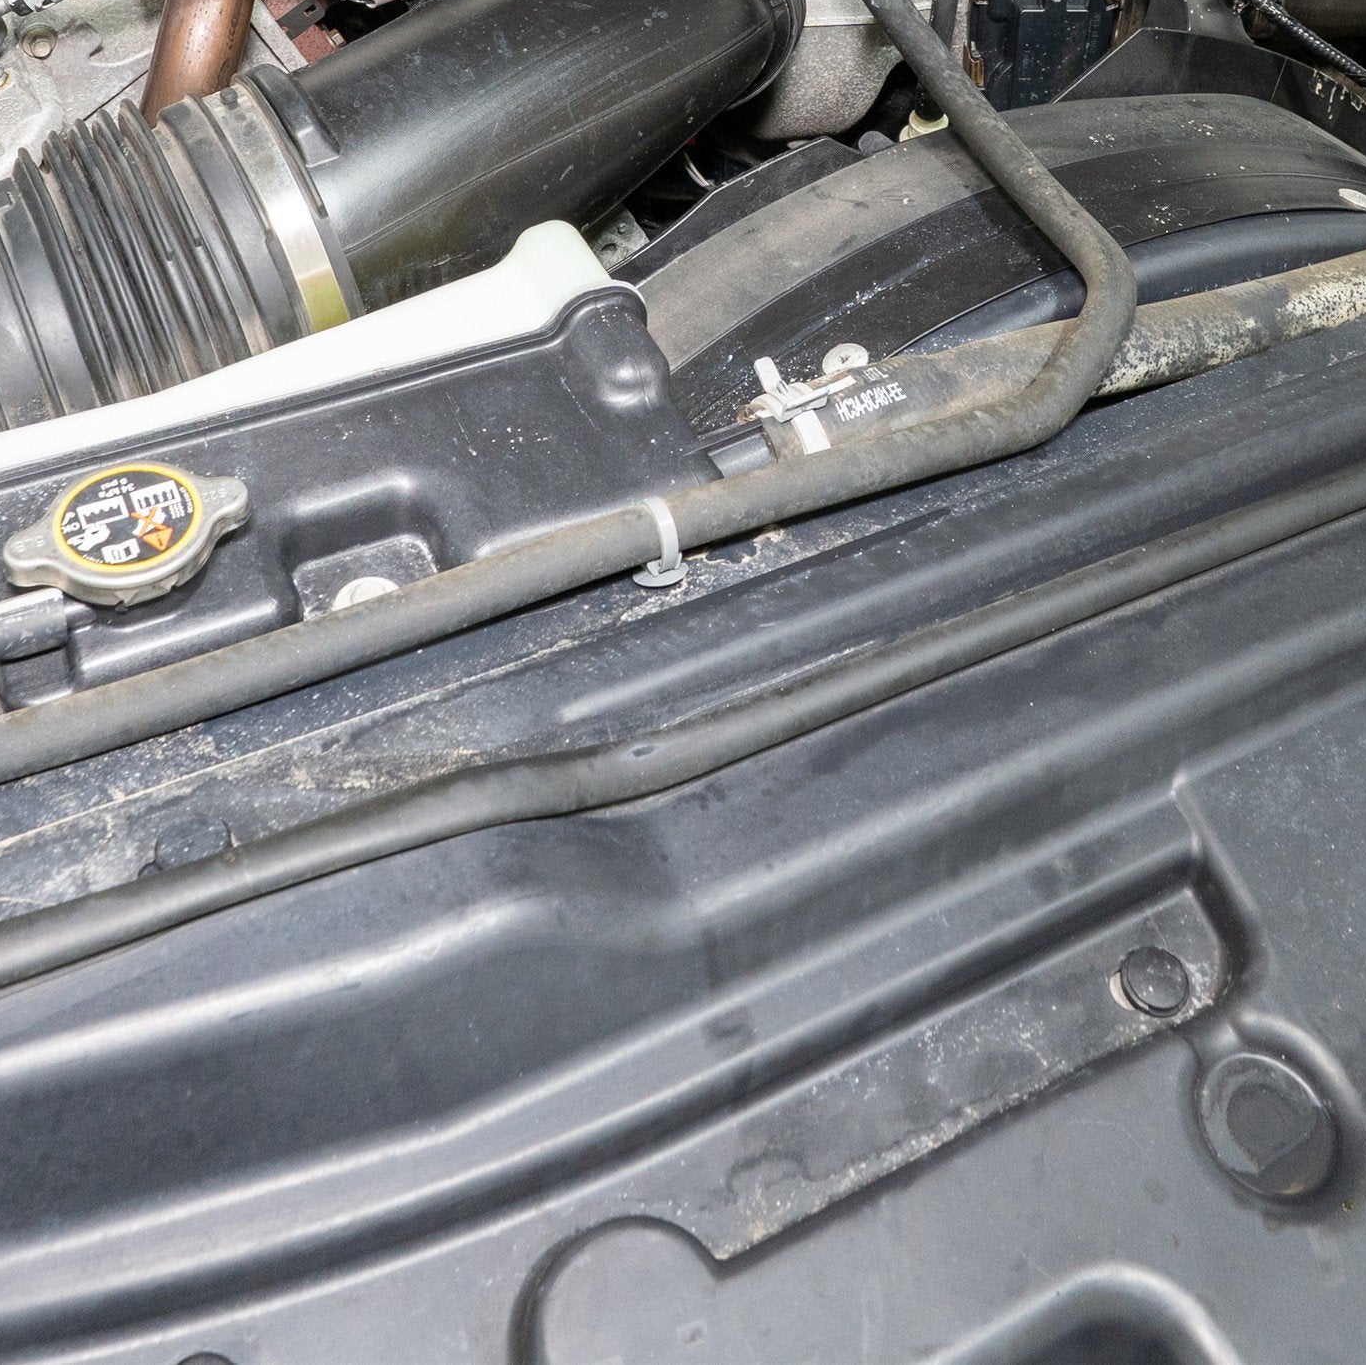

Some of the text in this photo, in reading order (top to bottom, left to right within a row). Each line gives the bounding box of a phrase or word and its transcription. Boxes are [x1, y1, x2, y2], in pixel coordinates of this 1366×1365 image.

[99, 483, 135, 498] 34 kPa
[62, 521, 79, 535] OK
